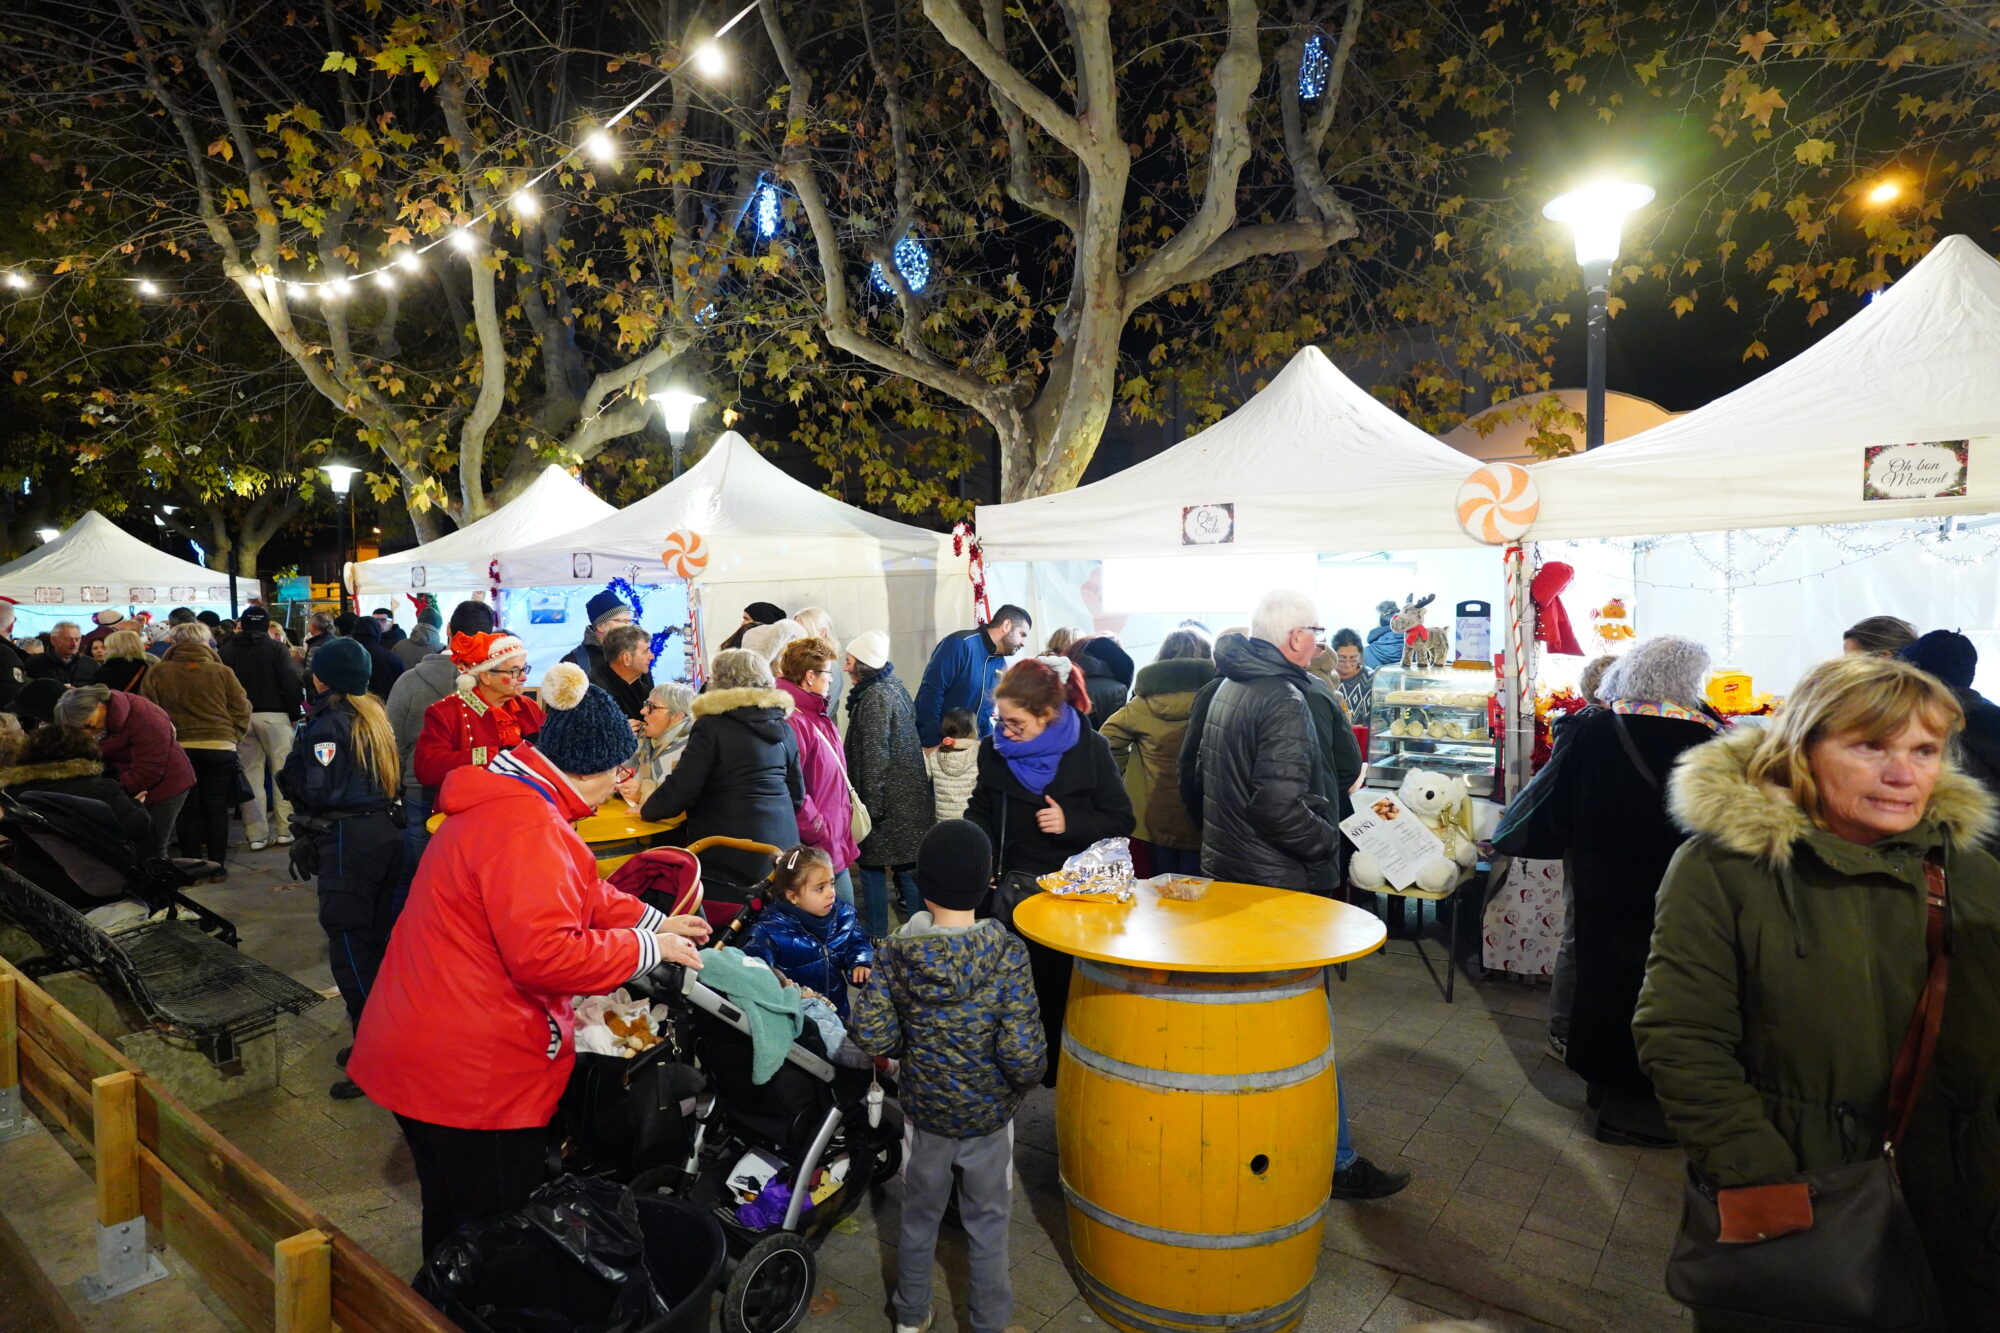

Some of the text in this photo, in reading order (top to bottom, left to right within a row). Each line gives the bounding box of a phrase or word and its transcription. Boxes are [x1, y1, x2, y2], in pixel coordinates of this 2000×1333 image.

[1889, 458, 1940, 473] Oh bon
[1881, 471, 1949, 487] Moment
[1351, 820, 1377, 838] MENU
